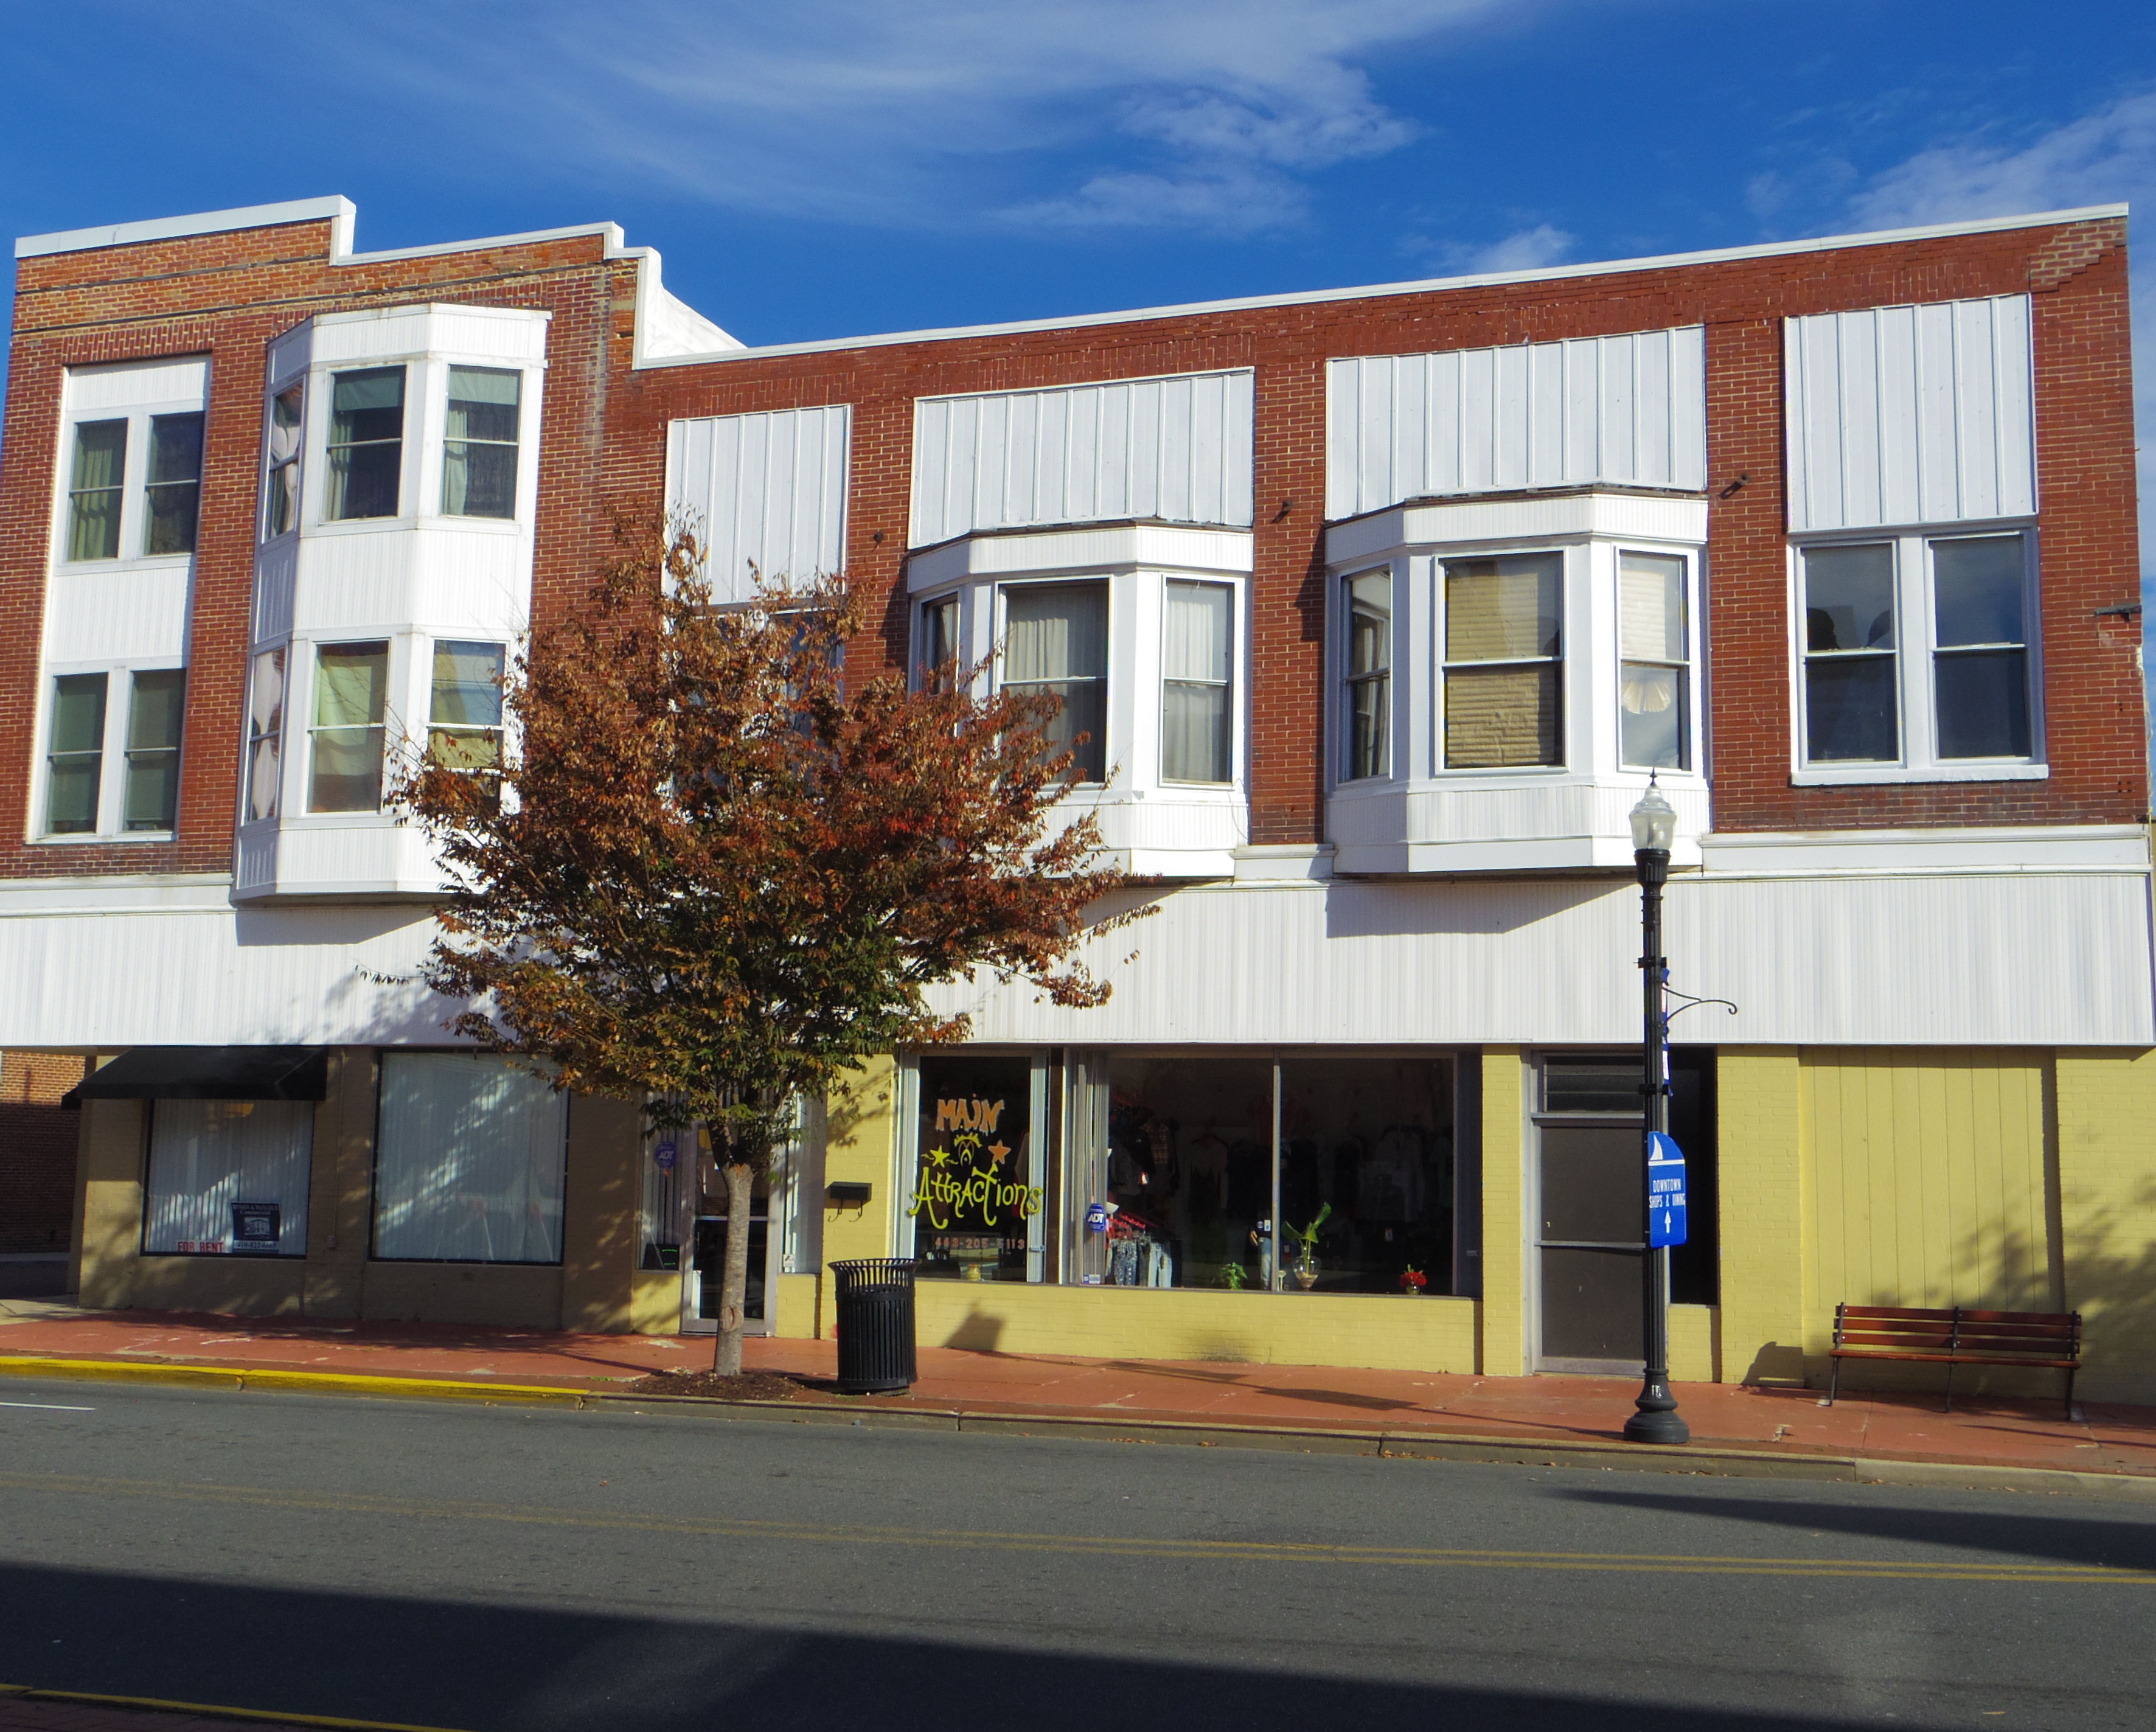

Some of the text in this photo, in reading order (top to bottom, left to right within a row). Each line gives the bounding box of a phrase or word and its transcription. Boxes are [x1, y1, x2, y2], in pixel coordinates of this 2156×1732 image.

[936, 1096, 1004, 1136] MAIN
[658, 1150, 674, 1160] ADT
[1653, 1178, 1681, 1192] DOWNTOWN
[1649, 1195, 1663, 1208] SHOPS
[1666, 1194, 1669, 1207] &
[1087, 1213, 1104, 1223] ADT
[178, 1241, 224, 1253] FOR RENT
